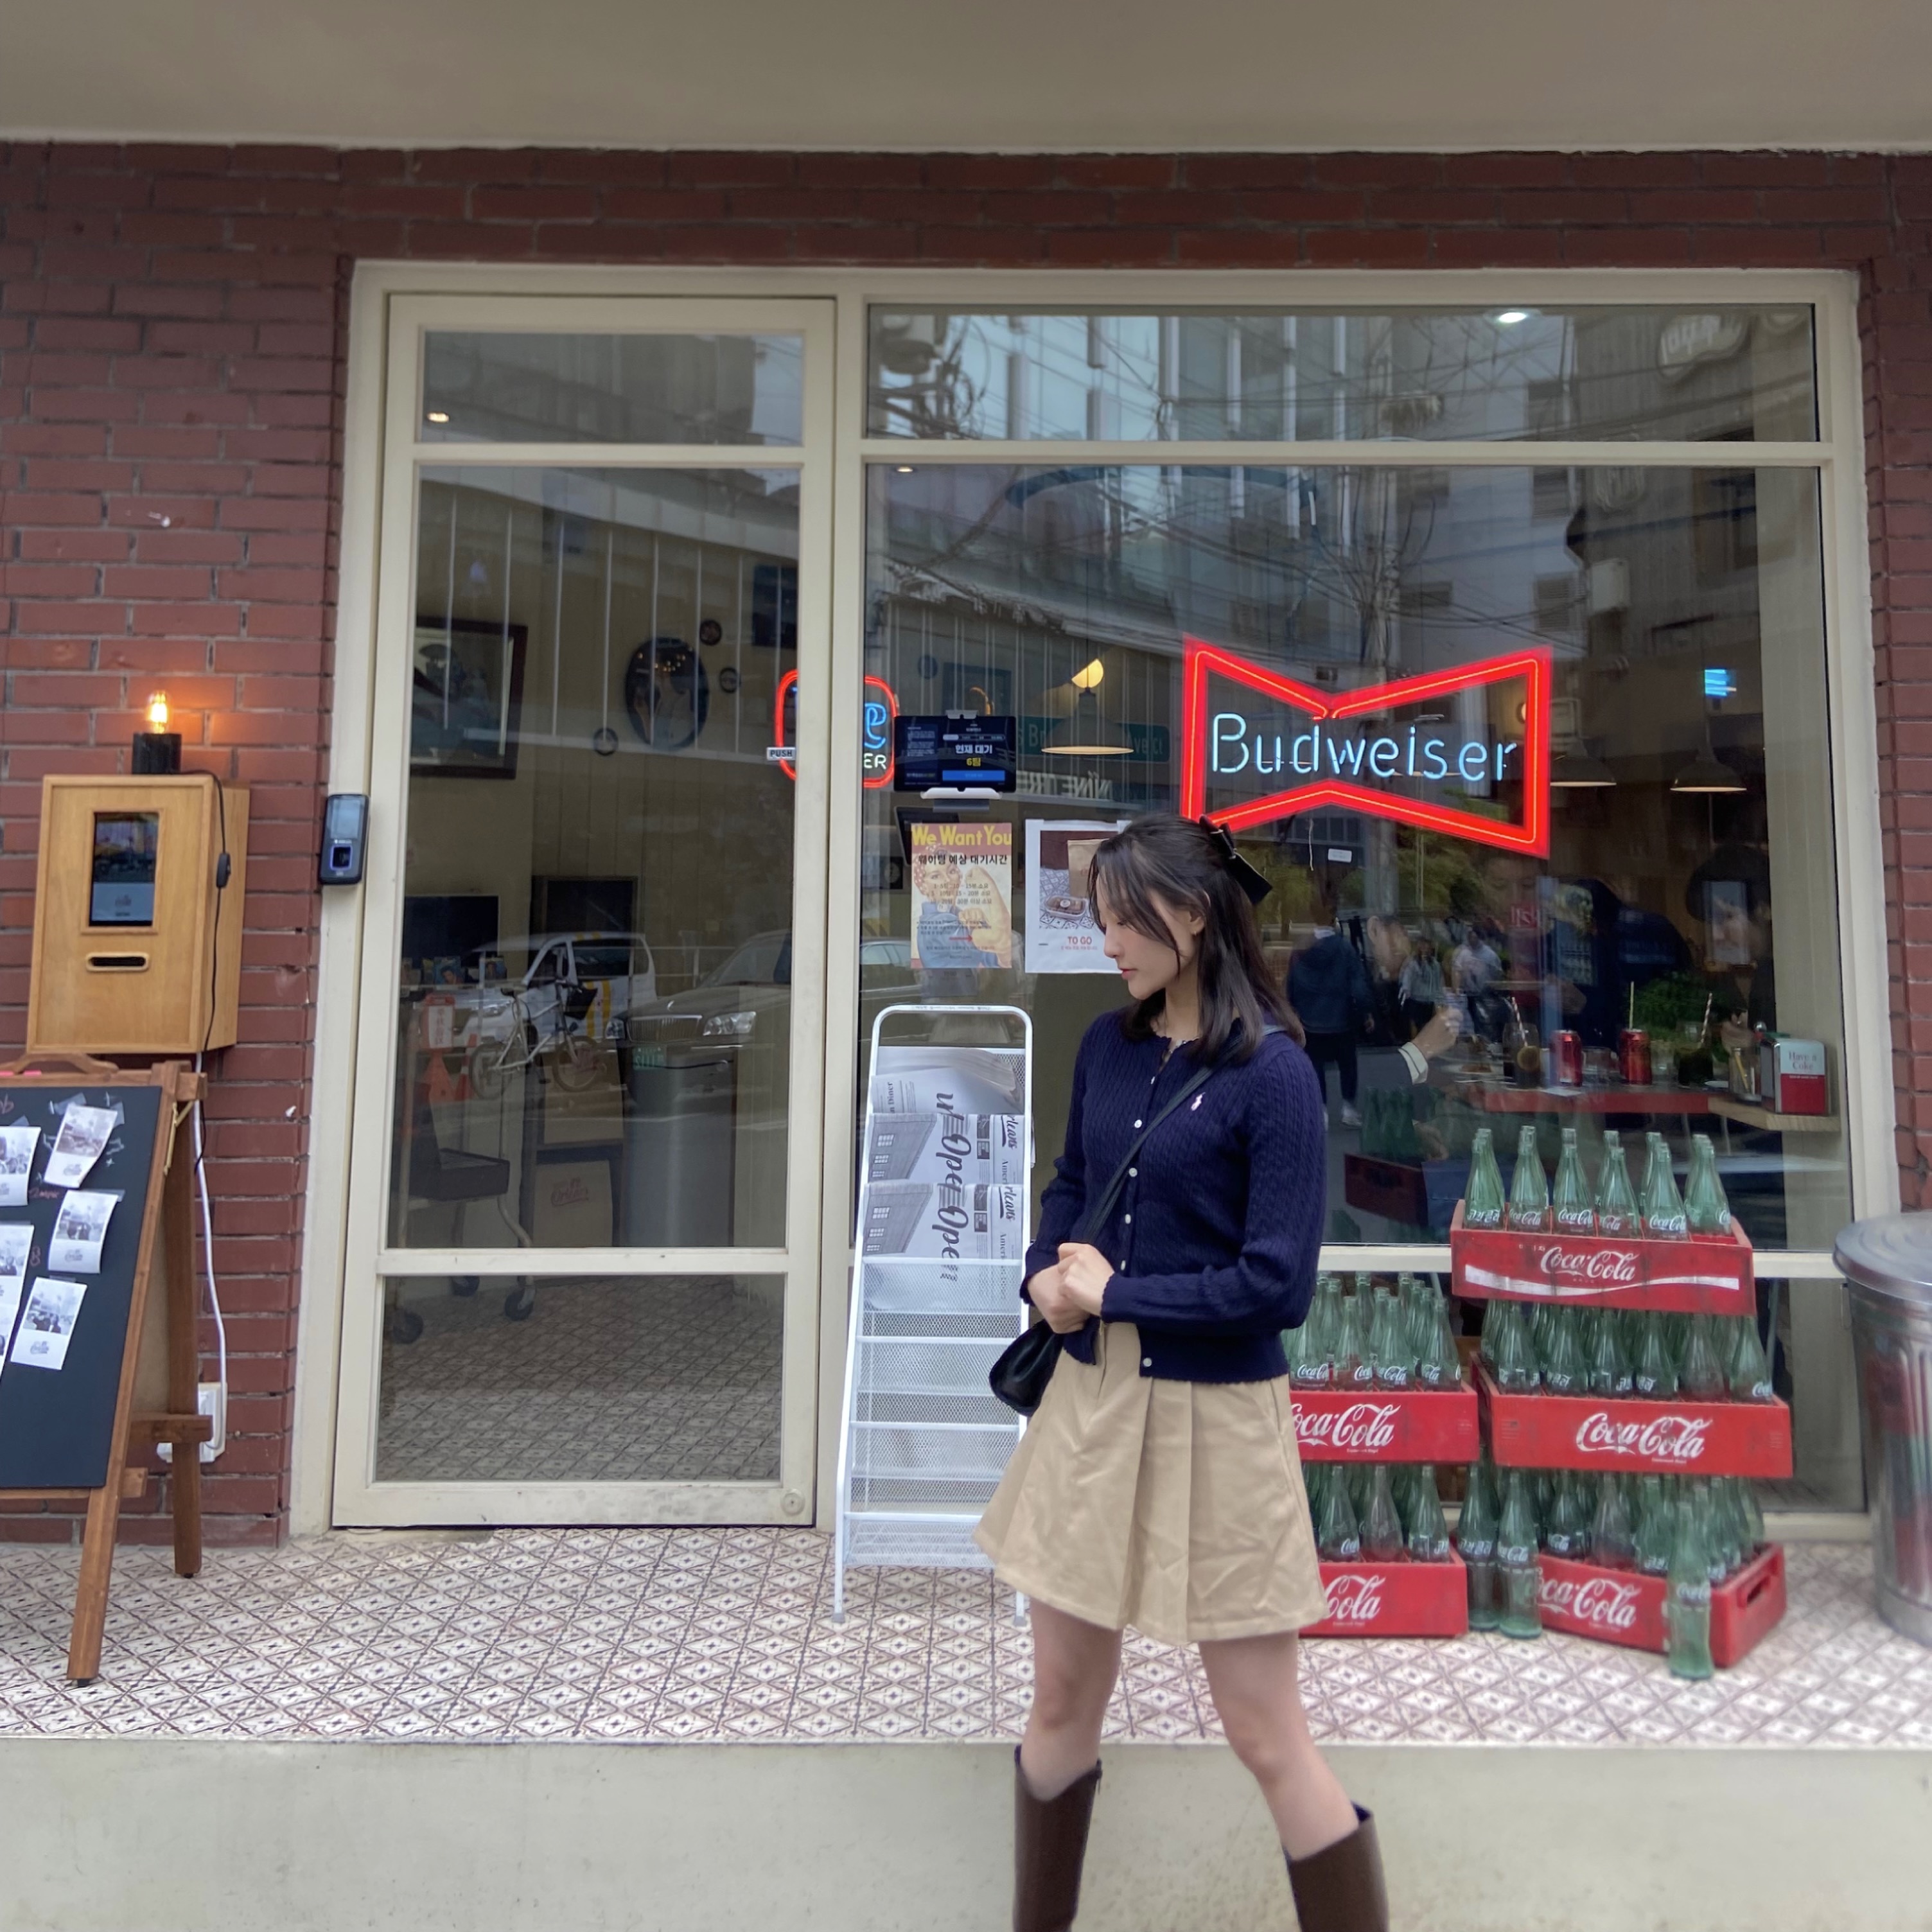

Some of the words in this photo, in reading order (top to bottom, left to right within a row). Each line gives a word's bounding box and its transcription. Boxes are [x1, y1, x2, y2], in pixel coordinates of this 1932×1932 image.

[955, 744, 973, 754] 현재
[975, 744, 992, 754] 대기
[1212, 713, 1516, 782] Budweiser
[967, 758, 981, 767] 6팀
[912, 825, 937, 846] We
[939, 825, 983, 846] Want
[983, 825, 1012, 846] You
[918, 855, 945, 865] 웨이팅
[949, 855, 967, 865] 예상
[970, 855, 1007, 865] 대기시간
[1067, 936, 1078, 944] TO
[1080, 936, 1092, 944] GO
[1006, 1116, 1019, 1150] rleans
[936, 1133, 971, 1185] Ope
[1004, 1186, 1017, 1221] rleans
[932, 1206, 969, 1259] Ope
